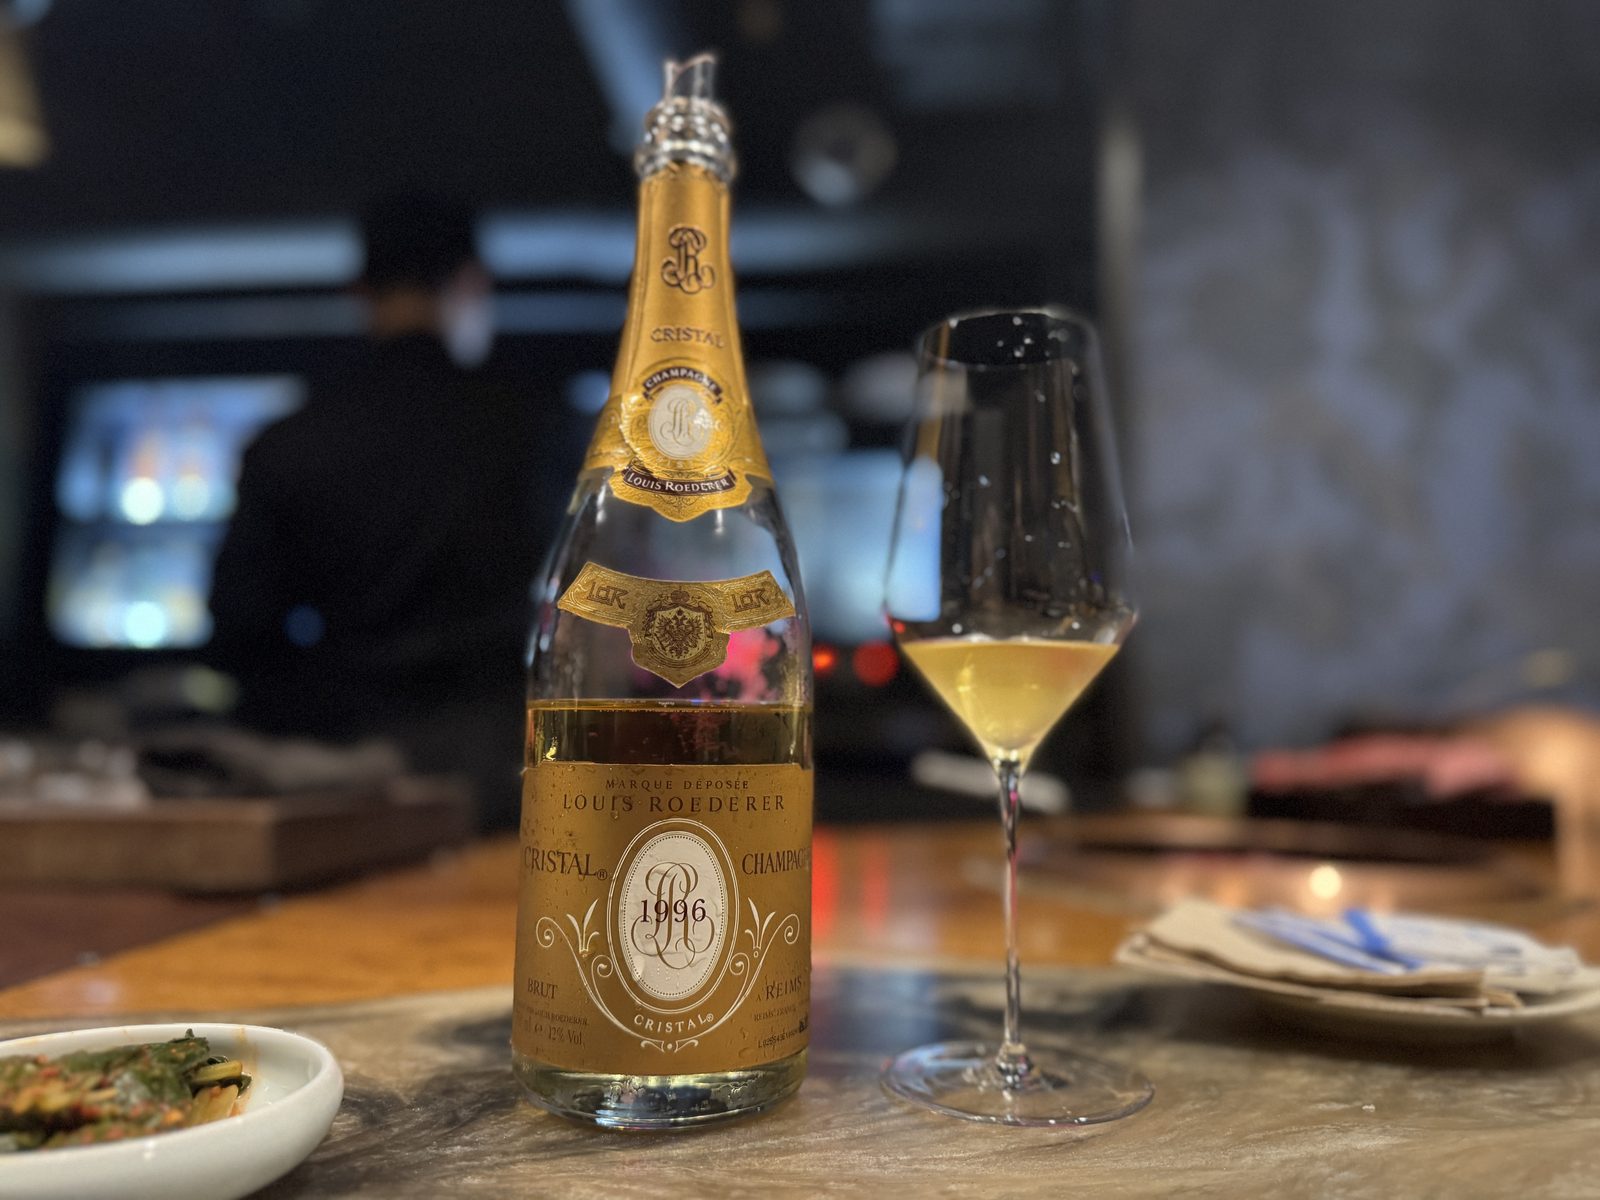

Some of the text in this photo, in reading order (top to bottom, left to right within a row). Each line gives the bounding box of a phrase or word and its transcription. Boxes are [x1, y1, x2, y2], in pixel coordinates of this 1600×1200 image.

[650, 328, 725, 349] CRISTAL
[605, 779, 673, 793] MARQUE
[563, 794, 785, 812] LOUIS ROEDERER
[639, 898, 707, 924] 1996
[527, 977, 559, 1000] BRUT
[766, 975, 802, 1000] REIMS
